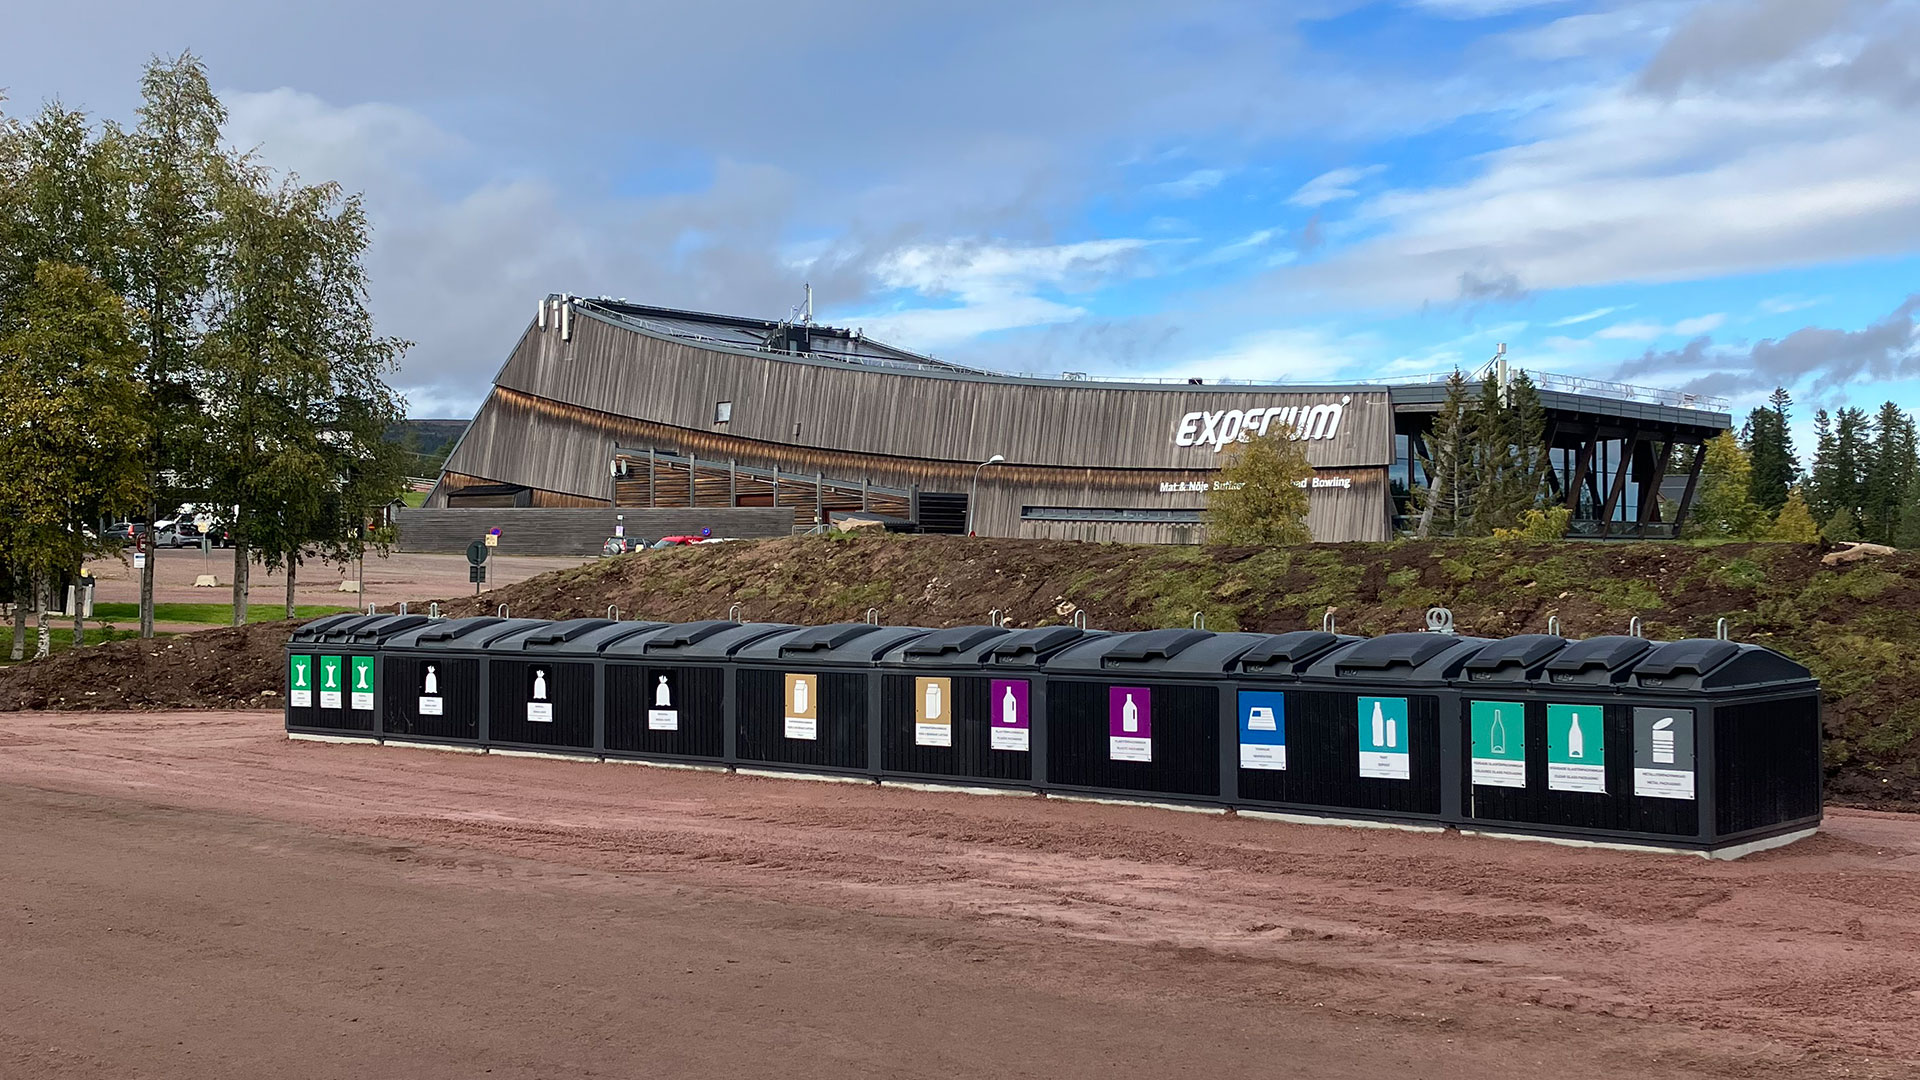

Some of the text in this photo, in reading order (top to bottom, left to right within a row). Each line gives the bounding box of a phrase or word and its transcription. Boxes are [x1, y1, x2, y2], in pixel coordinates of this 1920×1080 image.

[1159, 482, 1178, 492] Mat
[1189, 481, 1209, 494] Nöje
[1312, 476, 1351, 489] Bowling
